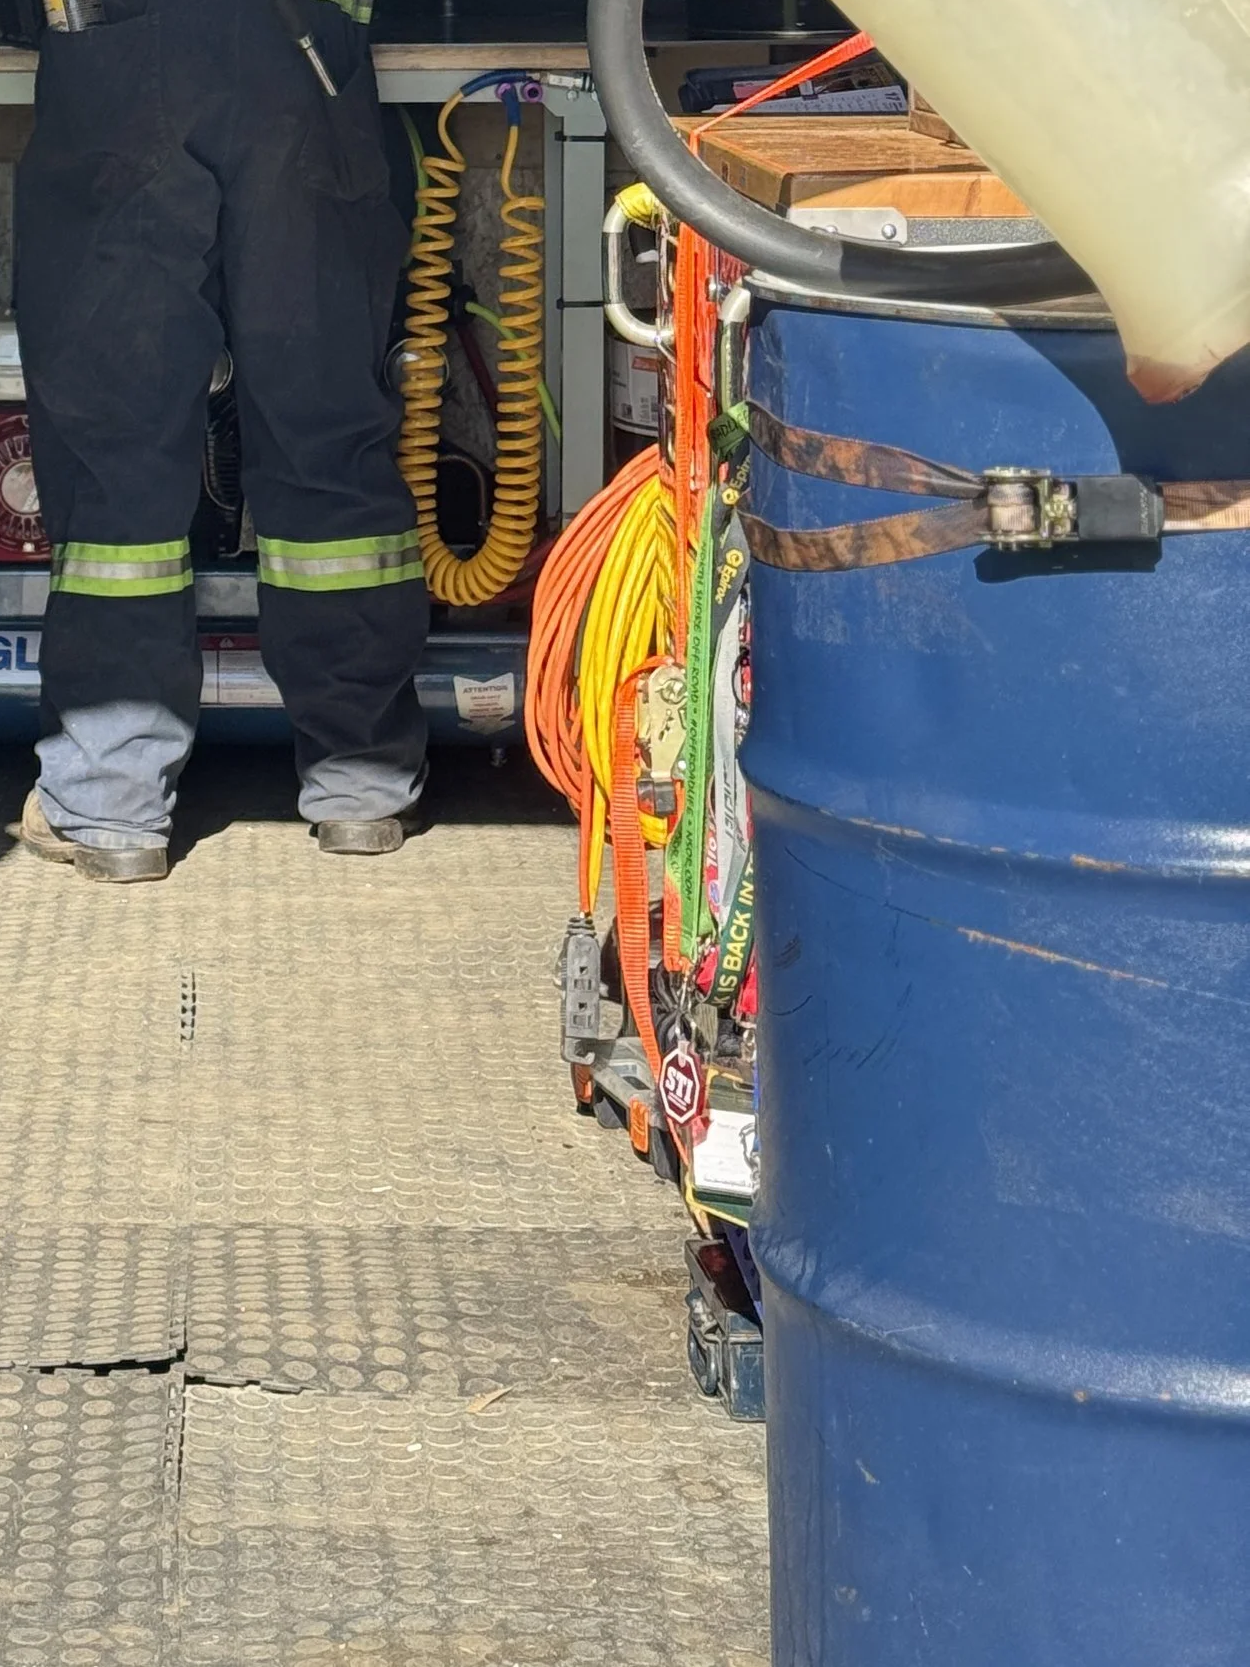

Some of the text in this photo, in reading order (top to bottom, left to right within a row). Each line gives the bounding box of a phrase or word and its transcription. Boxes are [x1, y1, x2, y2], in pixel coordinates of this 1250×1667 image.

[697, 541, 708, 585] NORTH
[715, 564, 738, 605] Epiroc
[693, 589, 703, 632] SHORE
[463, 685, 508, 694] ATTENTION
[690, 636, 701, 702] OFF-ROAD
[738, 880, 754, 907] IN
[722, 909, 752, 972] BACK
[717, 974, 738, 993] IS
[665, 1066, 694, 1105] STI
